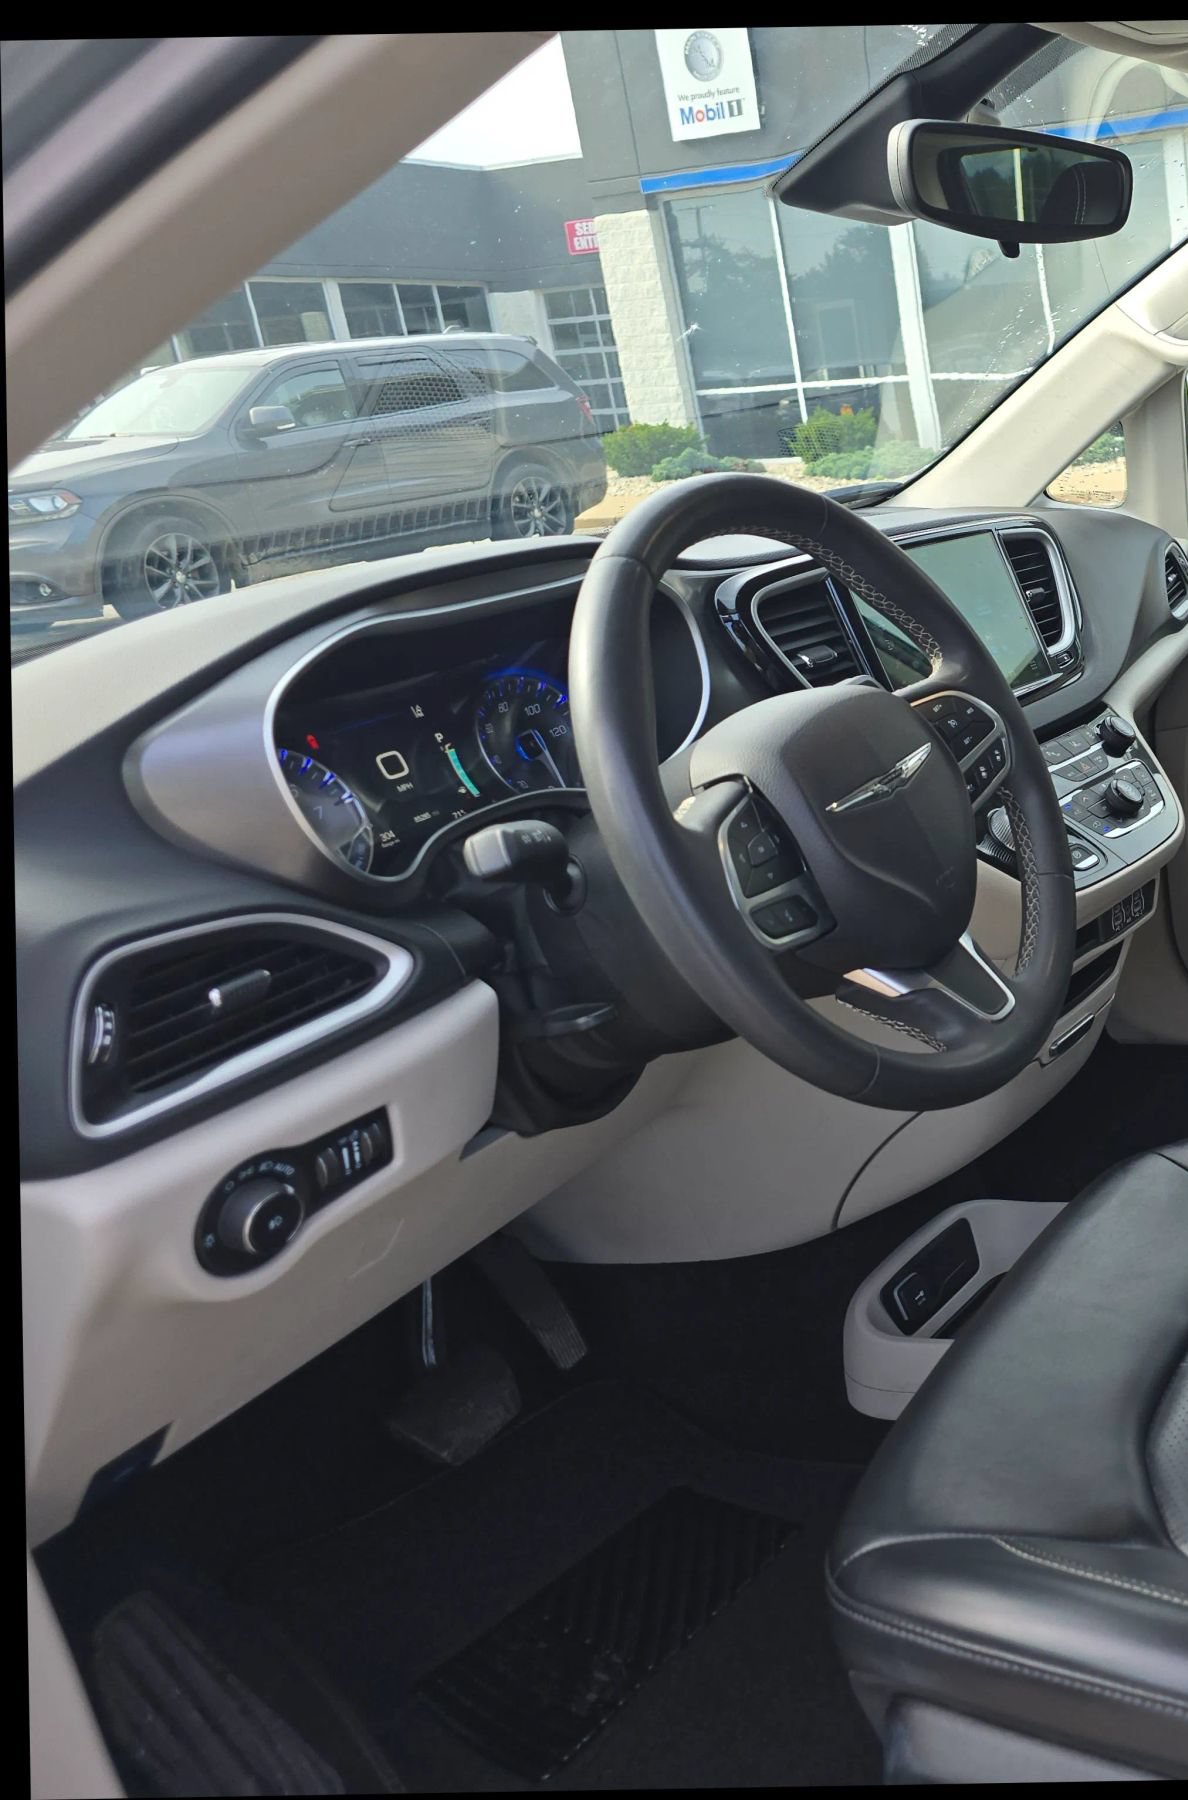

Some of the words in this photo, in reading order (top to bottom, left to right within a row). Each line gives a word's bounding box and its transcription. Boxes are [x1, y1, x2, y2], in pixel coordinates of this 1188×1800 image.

[678, 94, 690, 102] We
[691, 89, 716, 102] proudly
[717, 87, 739, 95] feature
[680, 102, 725, 125] Mobil
[524, 703, 541, 716] 100
[434, 732, 444, 743] P
[549, 724, 567, 738] 120
[375, 750, 410, 780] 0
[396, 782, 414, 793] MPH
[379, 829, 396, 842] 304
[273, 1164, 295, 1175] AUTO
